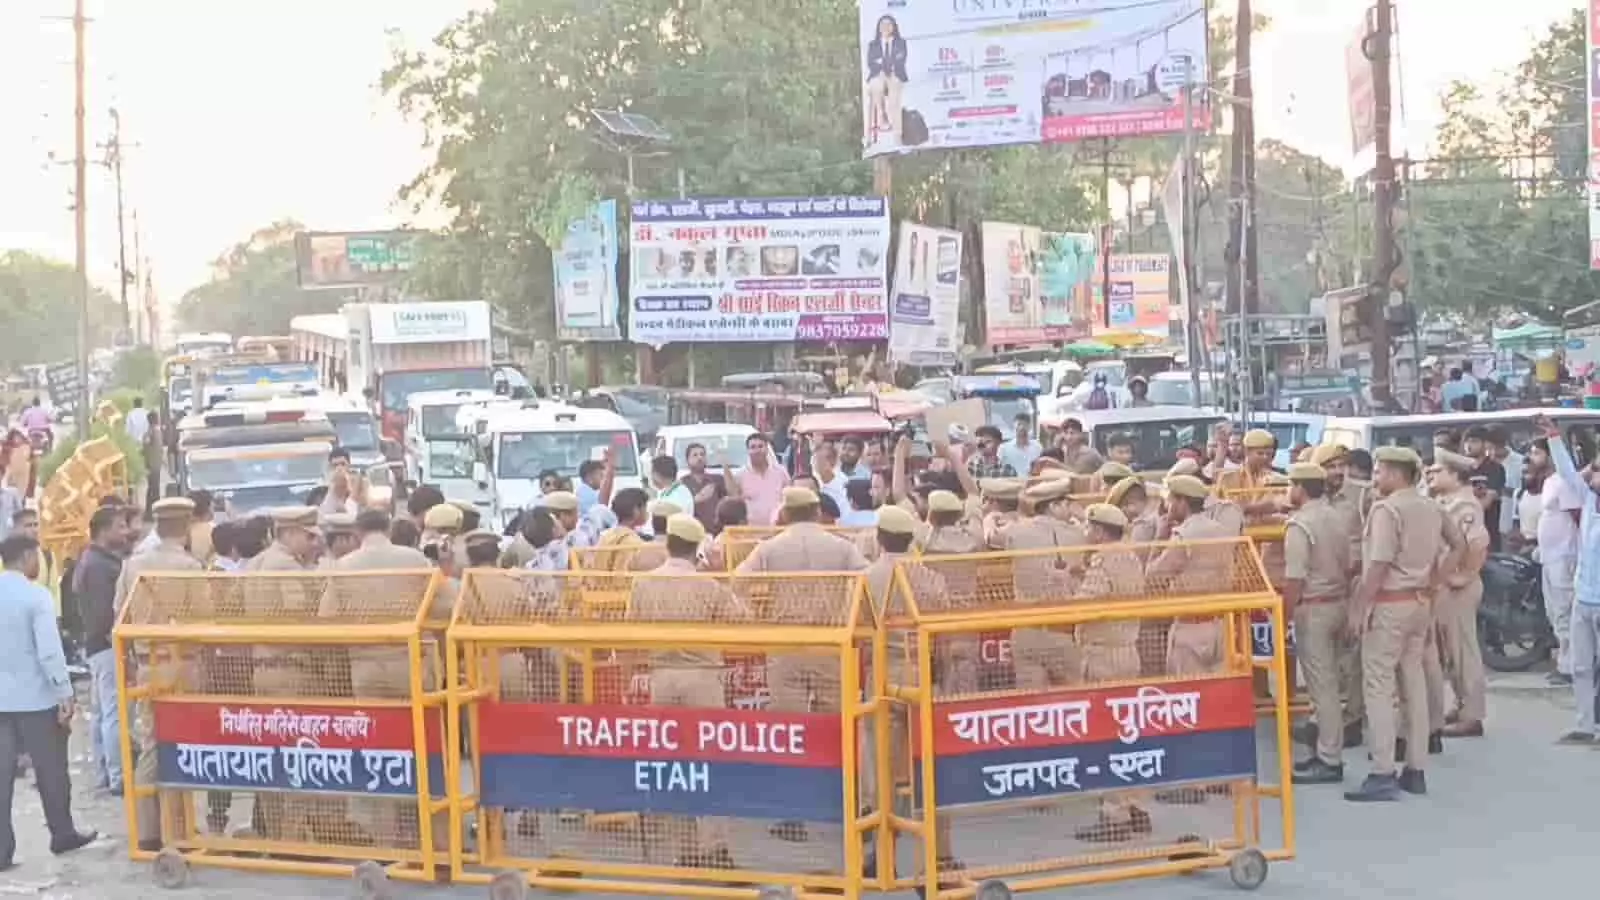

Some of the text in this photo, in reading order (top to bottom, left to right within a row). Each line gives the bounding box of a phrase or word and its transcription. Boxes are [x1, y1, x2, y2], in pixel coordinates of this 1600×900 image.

[557, 715, 806, 754] TRAFFIC POLICE
[948, 686, 1200, 745] यातायात पुलिस
[176, 735, 414, 791] यातायात पुलिस एटा
[634, 760, 710, 792] ETAH
[982, 757, 1081, 796] जनपद
